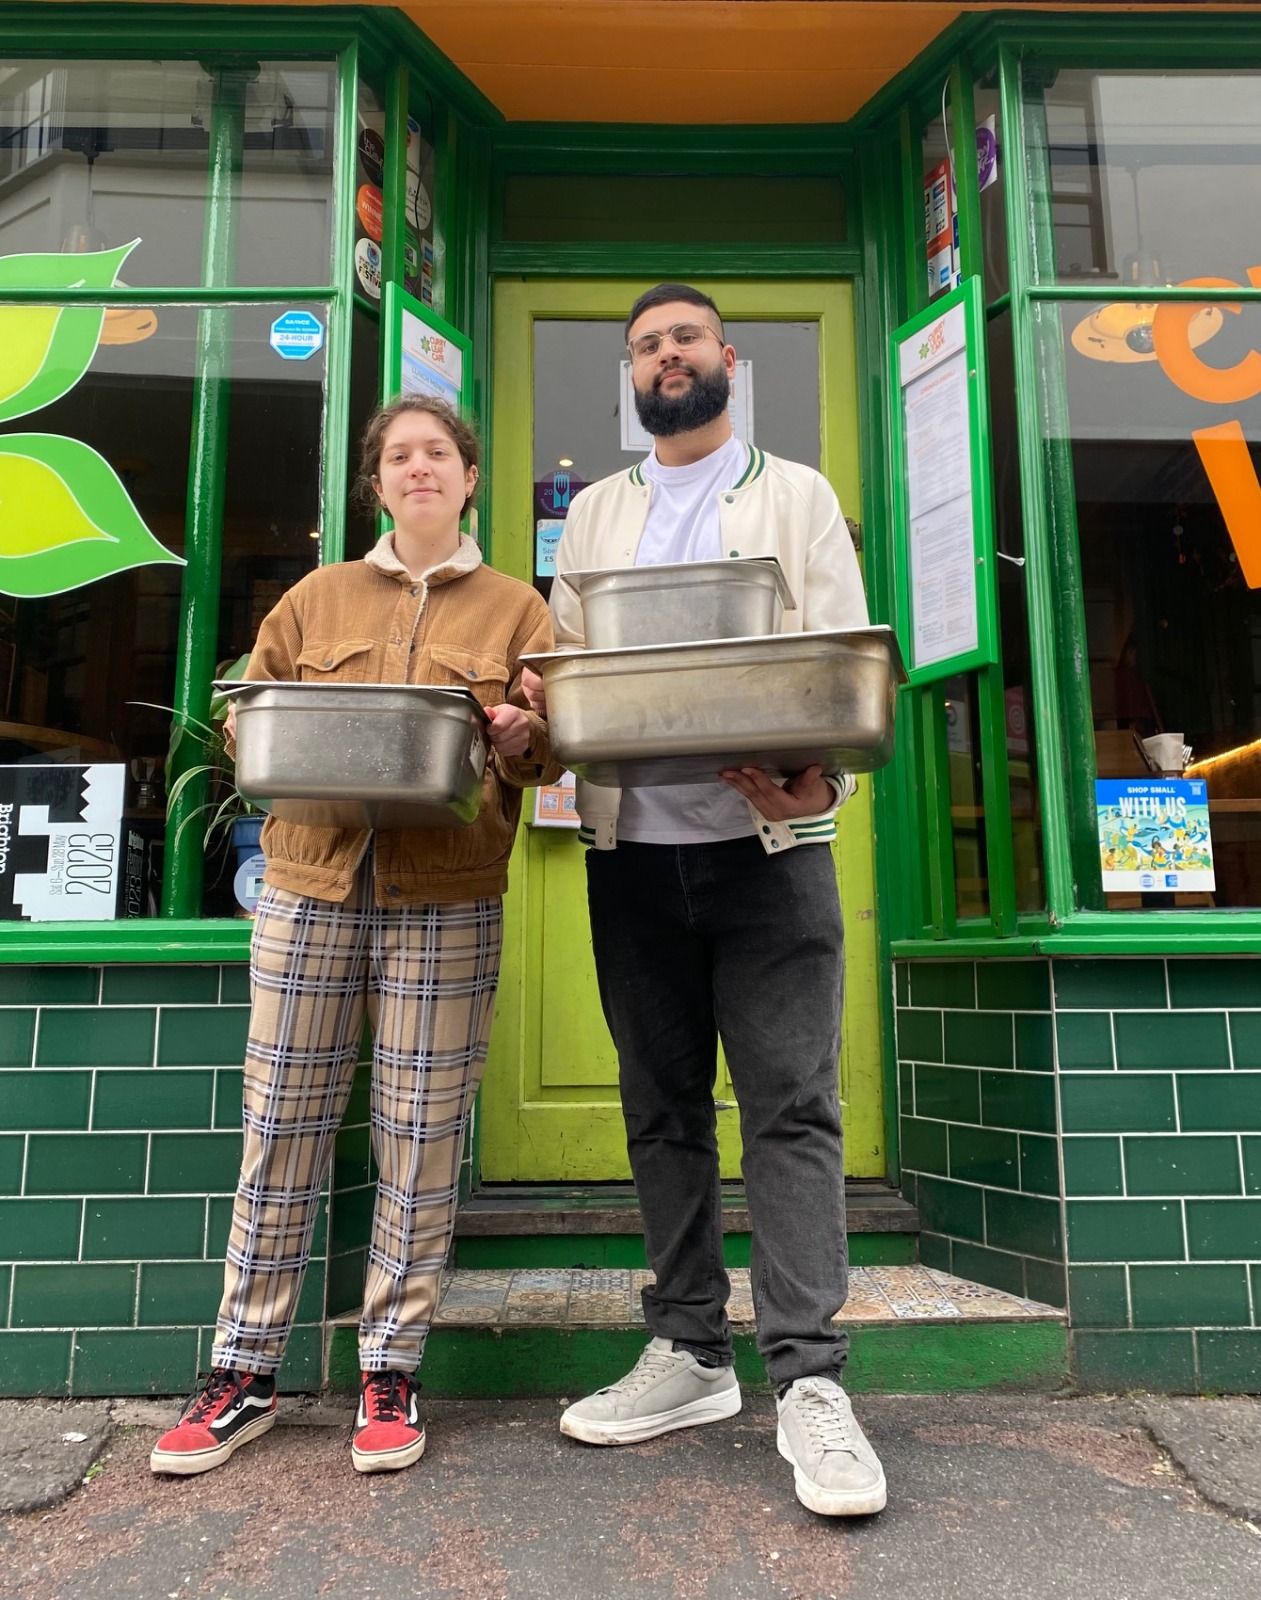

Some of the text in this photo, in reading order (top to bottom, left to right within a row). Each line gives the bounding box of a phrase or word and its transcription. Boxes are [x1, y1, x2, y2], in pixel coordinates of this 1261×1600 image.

[361, 199, 382, 223] WINNE
[279, 334, 313, 342] 24-HOUR
[430, 336, 446, 348] CURRY
[1127, 786, 1176, 794] SHOP SMALL
[1119, 796, 1187, 818] WITH US
[65, 833, 115, 895] 2023
